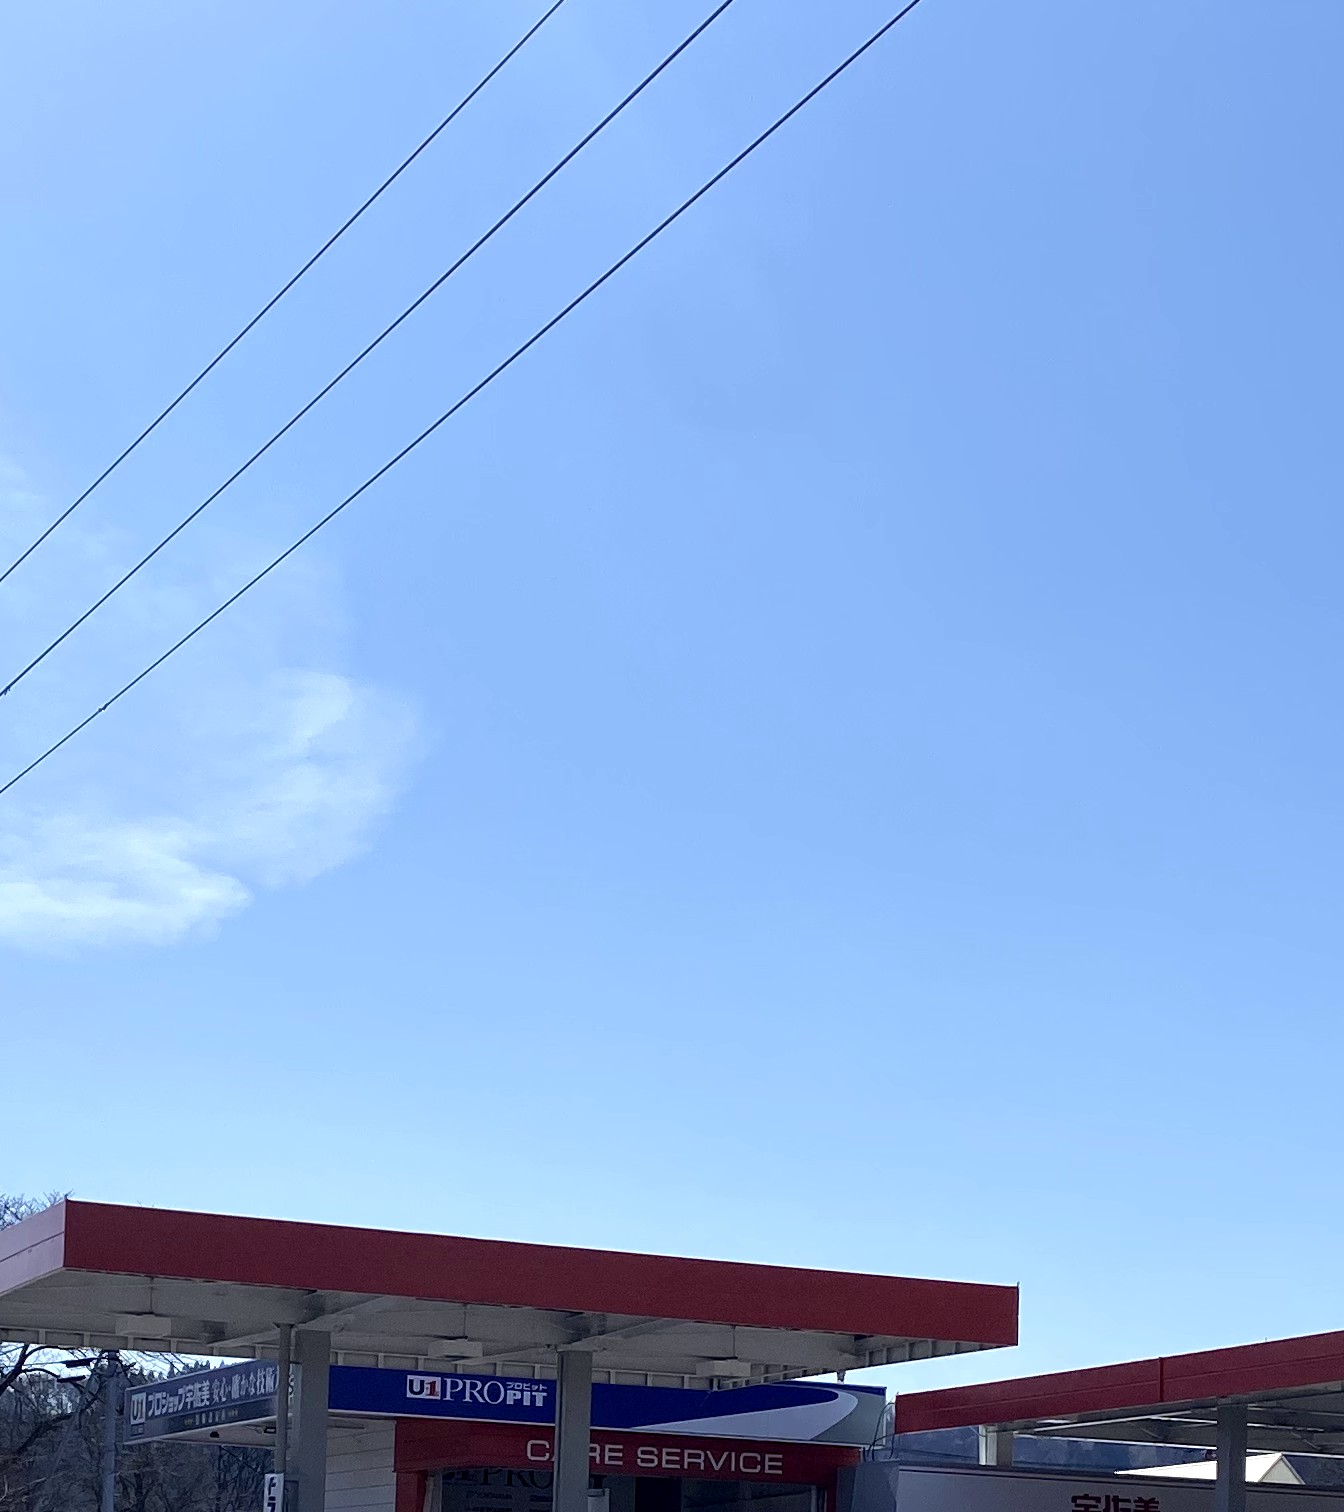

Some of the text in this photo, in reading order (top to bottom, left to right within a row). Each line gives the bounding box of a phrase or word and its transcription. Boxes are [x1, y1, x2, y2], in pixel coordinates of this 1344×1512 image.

[443, 1378, 505, 1405] PRO
[506, 1390, 548, 1407] PIT
[526, 1440, 784, 1475] CRE SERVICE
